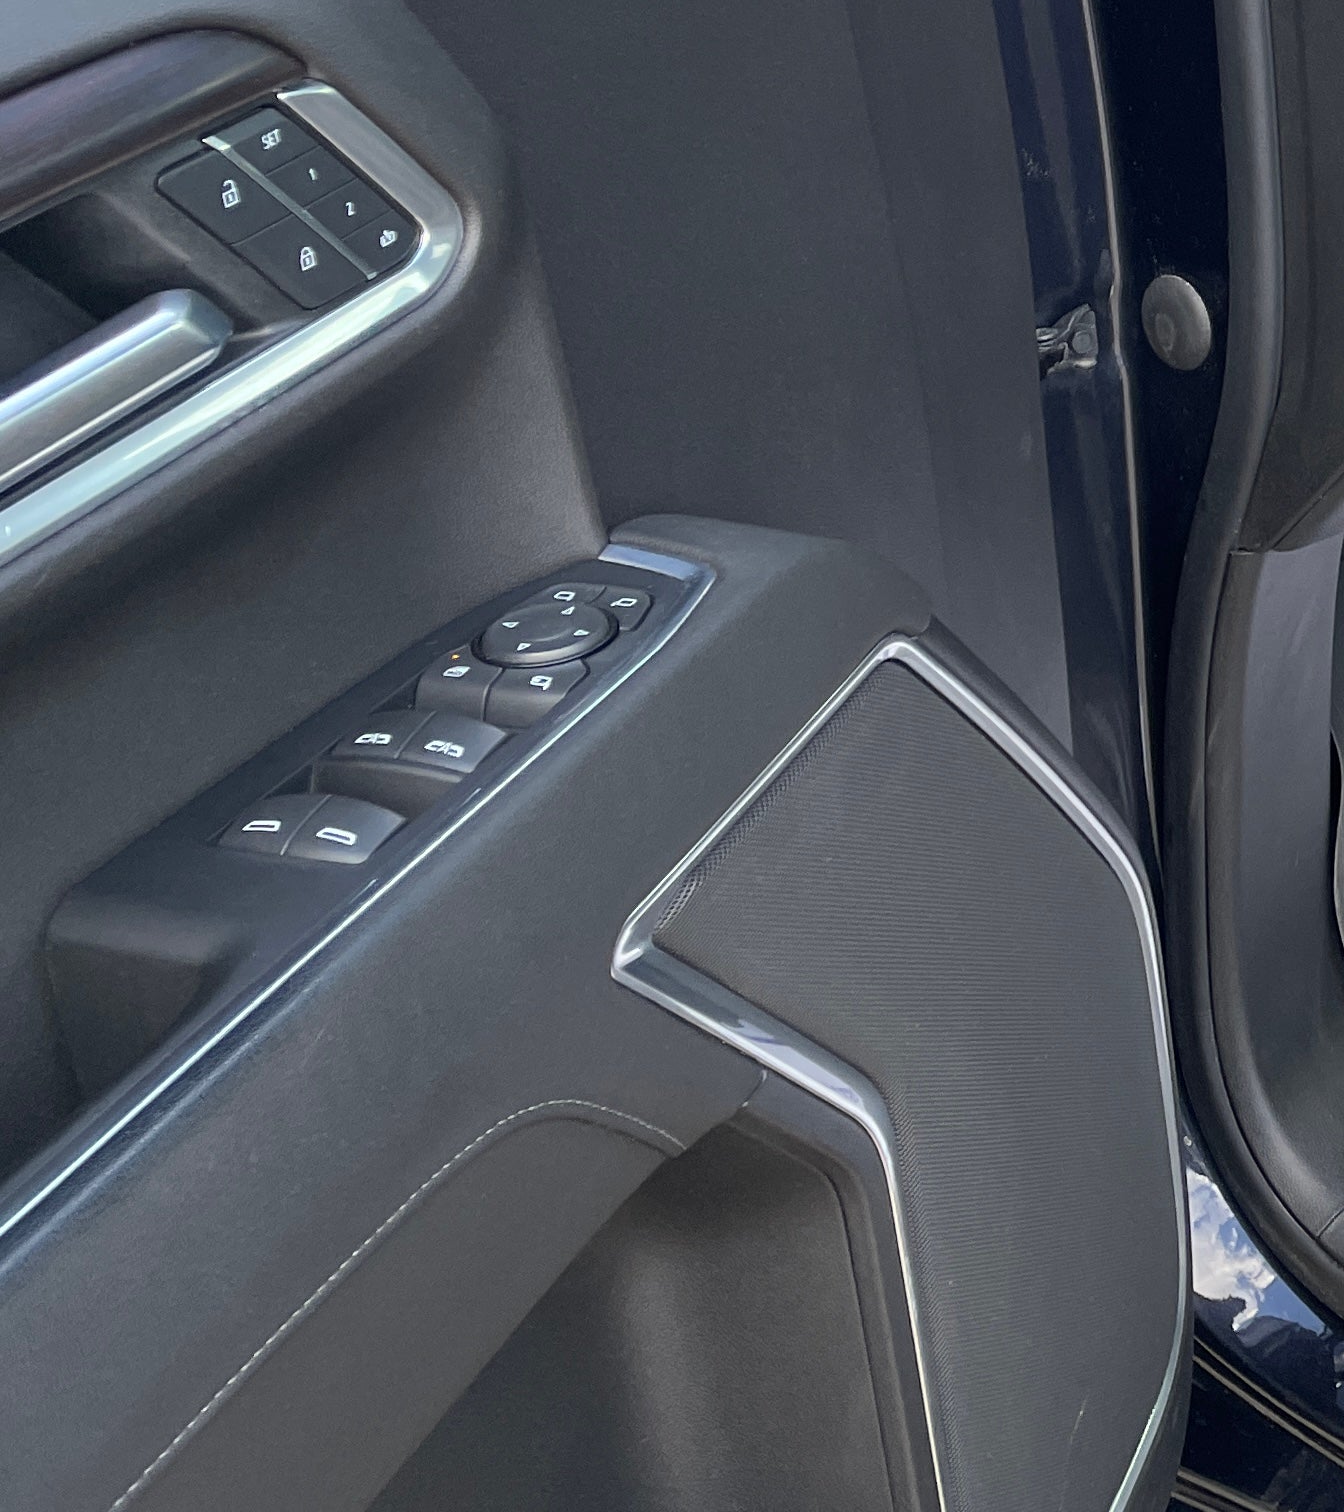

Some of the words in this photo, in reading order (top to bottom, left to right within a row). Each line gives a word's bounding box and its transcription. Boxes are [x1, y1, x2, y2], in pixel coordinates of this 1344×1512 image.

[261, 128, 281, 150] SET
[308, 168, 318, 181] 1
[345, 201, 356, 217] 2
